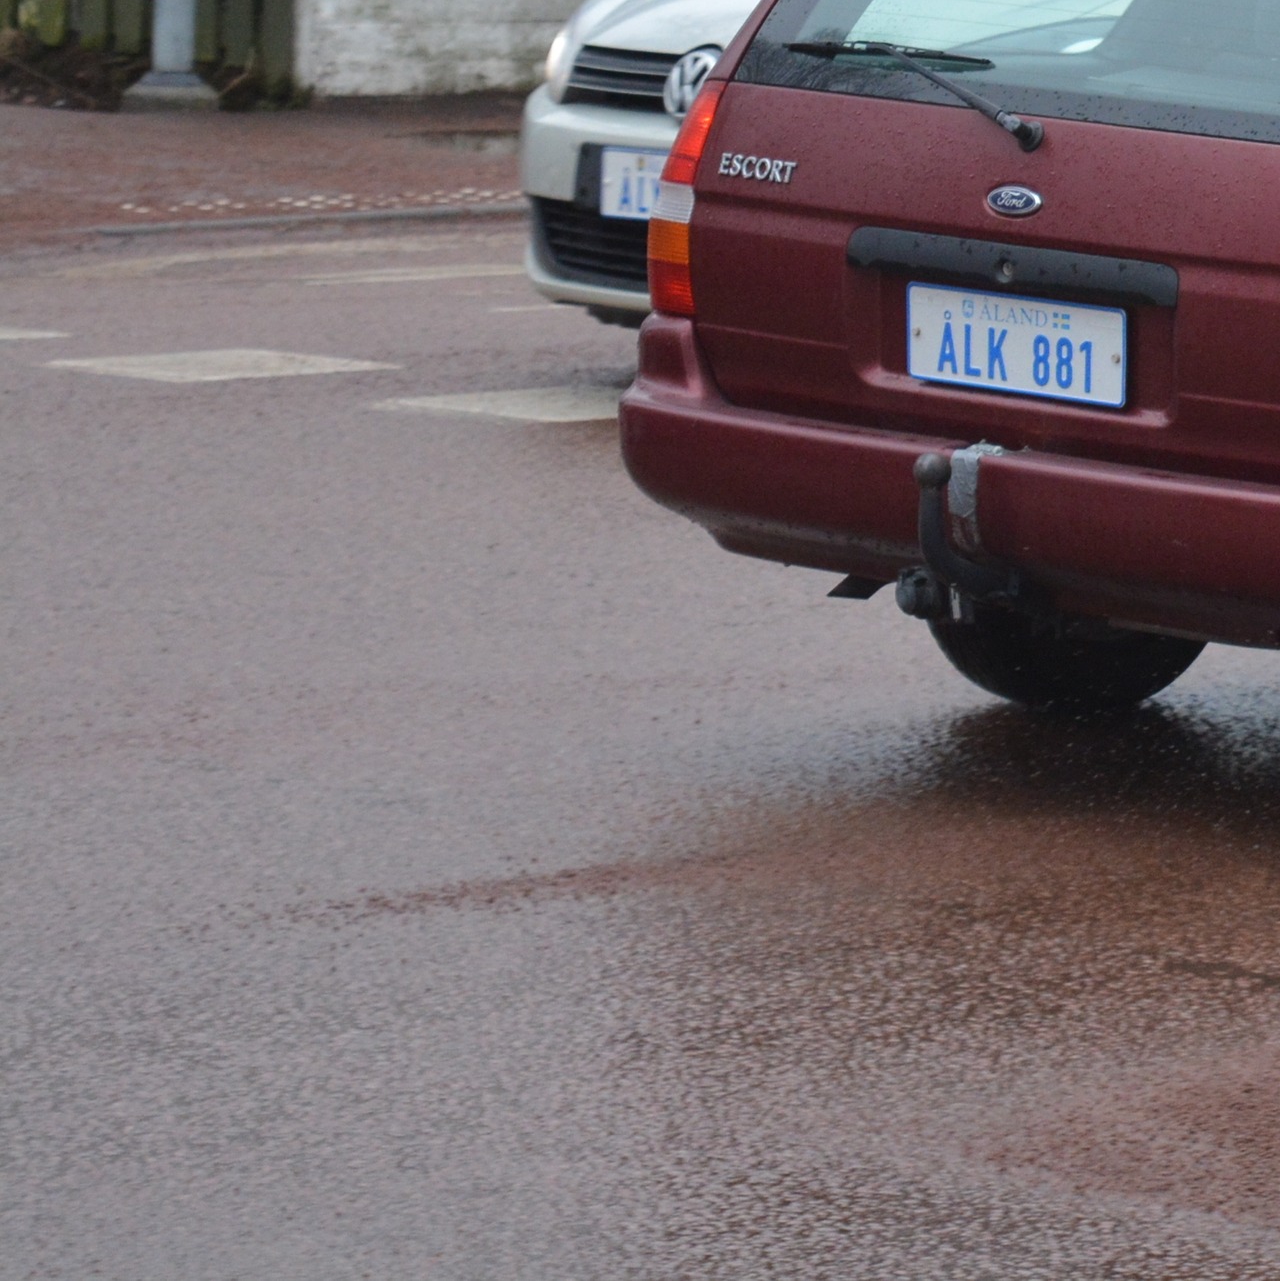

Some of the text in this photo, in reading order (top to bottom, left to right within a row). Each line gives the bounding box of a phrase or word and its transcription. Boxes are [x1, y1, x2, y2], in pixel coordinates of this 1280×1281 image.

[718, 151, 798, 185] ESCORT
[997, 190, 1028, 209] Ford
[979, 296, 1049, 328] ÅLAND
[937, 309, 1094, 395] ÅLK 881
